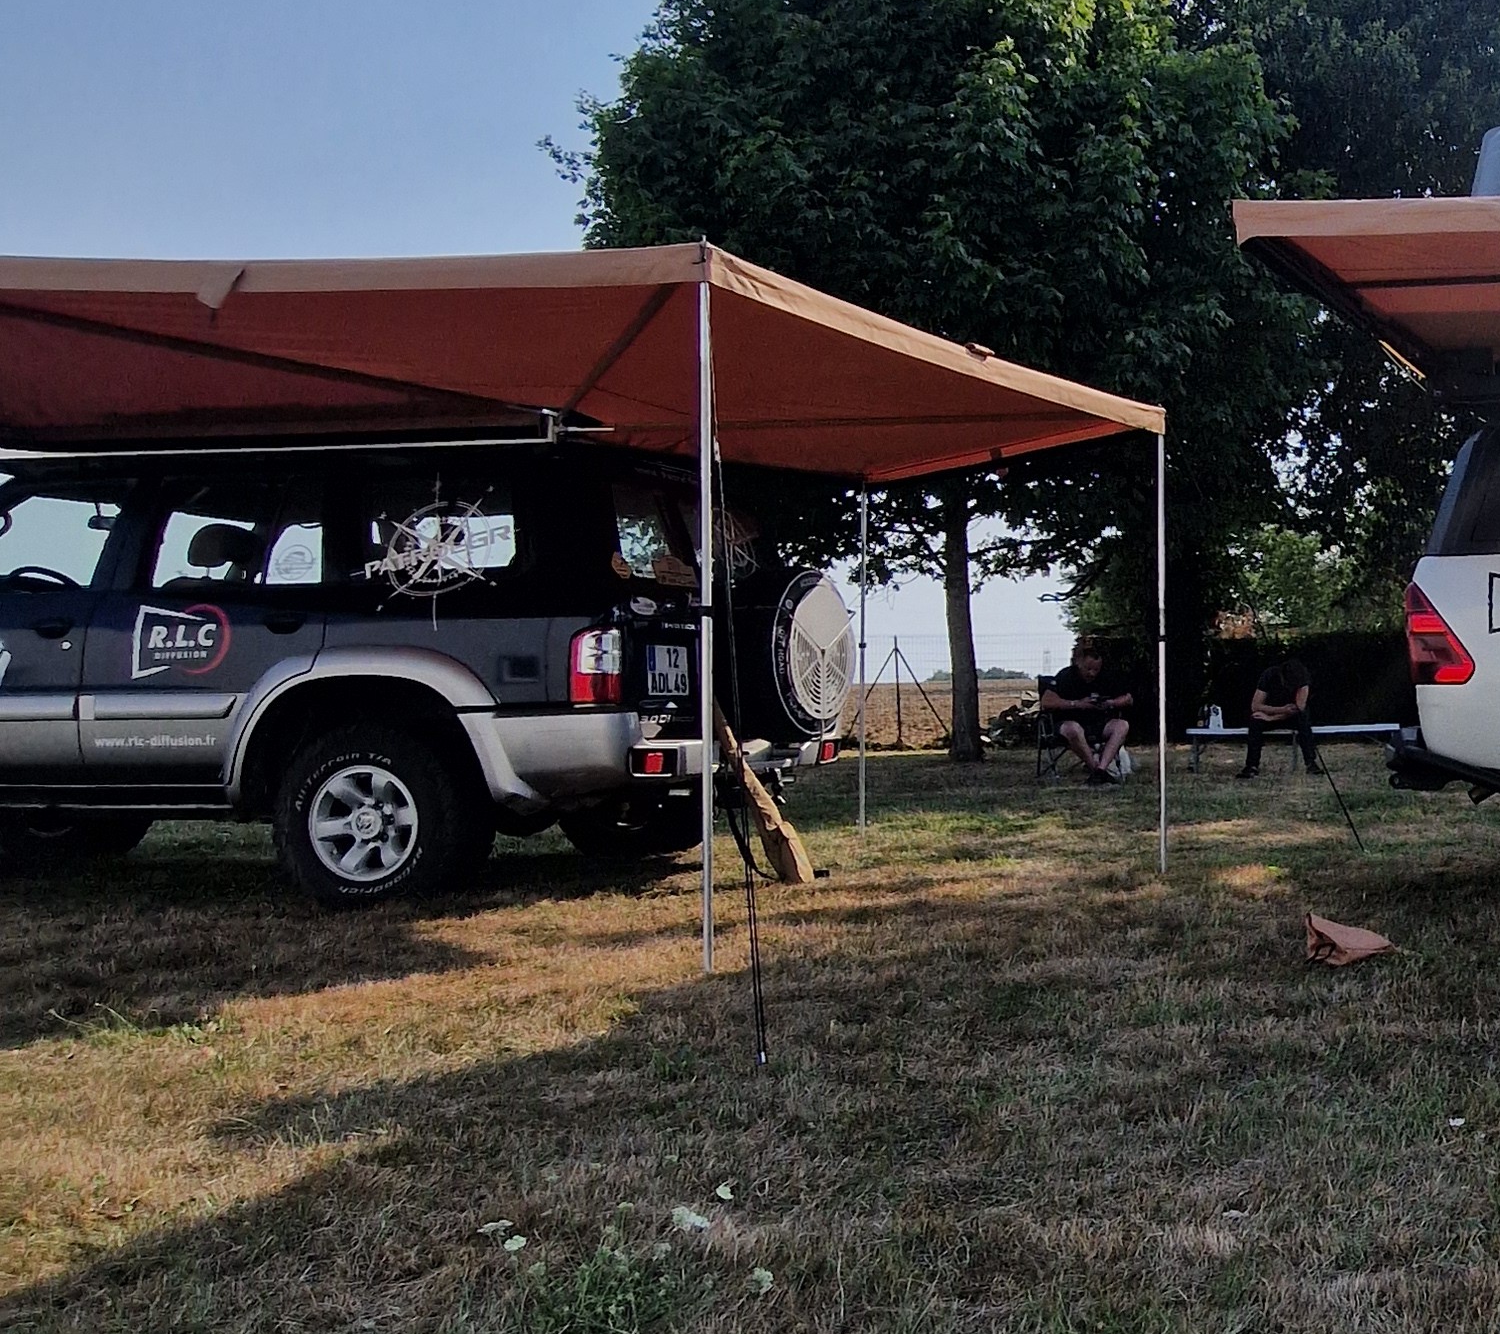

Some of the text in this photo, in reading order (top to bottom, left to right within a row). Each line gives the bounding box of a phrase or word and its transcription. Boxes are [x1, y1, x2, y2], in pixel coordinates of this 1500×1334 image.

[147, 623, 217, 649] R.L.C
[153, 650, 208, 660] DIFFUSION
[666, 647, 680, 669] 12
[651, 672, 688, 694] ADL 49
[94, 734, 217, 748] www.rlc-diffusion.fr
